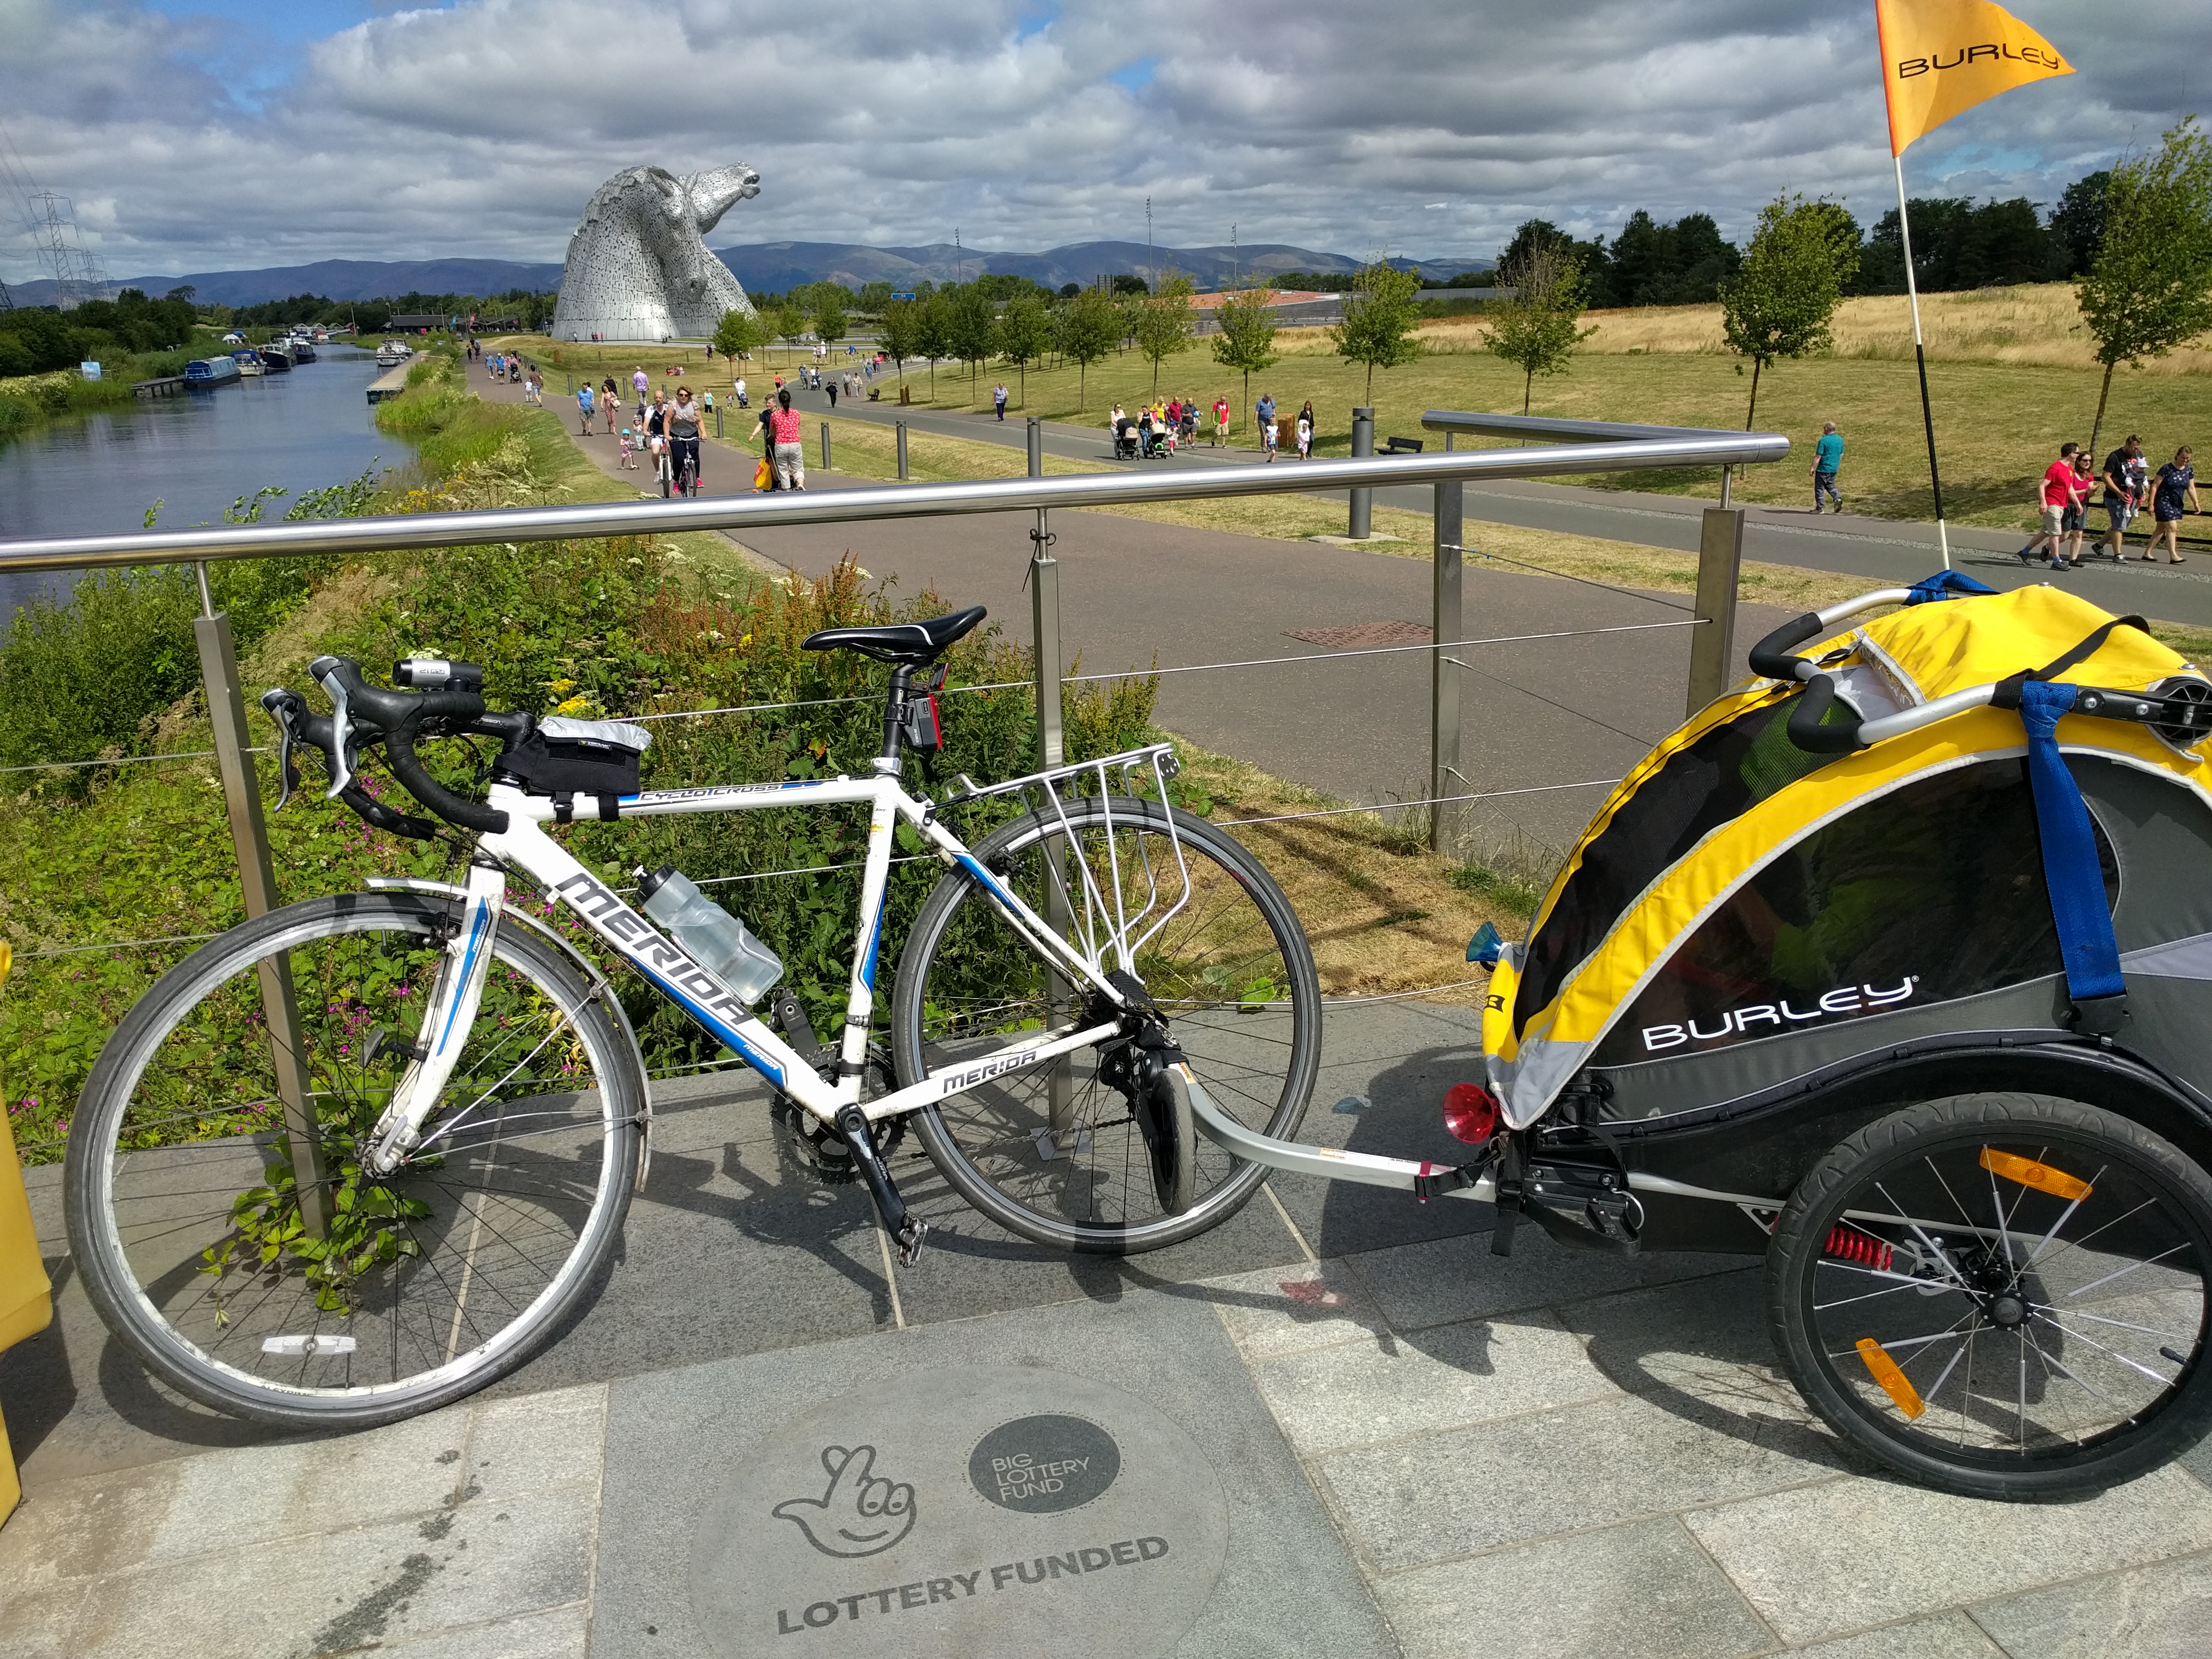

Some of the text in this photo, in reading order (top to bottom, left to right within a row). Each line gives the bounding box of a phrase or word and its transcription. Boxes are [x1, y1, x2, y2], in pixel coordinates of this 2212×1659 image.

[1899, 43, 2059, 79] BURLEY
[640, 785, 781, 801] CYCLO CROSS
[472, 918, 486, 953] MERIDA
[554, 872, 755, 1025] MERIDA
[1642, 976, 1914, 1051] BURLEY
[742, 1044, 779, 1070] MERIDA
[943, 1051, 1037, 1094] MERIDA
[991, 1453, 1033, 1472] BIG
[996, 1457, 1090, 1486] LOTTERY
[1000, 1479, 1064, 1502] FUND
[777, 1536, 1170, 1635] LOTTERY FUNDED
